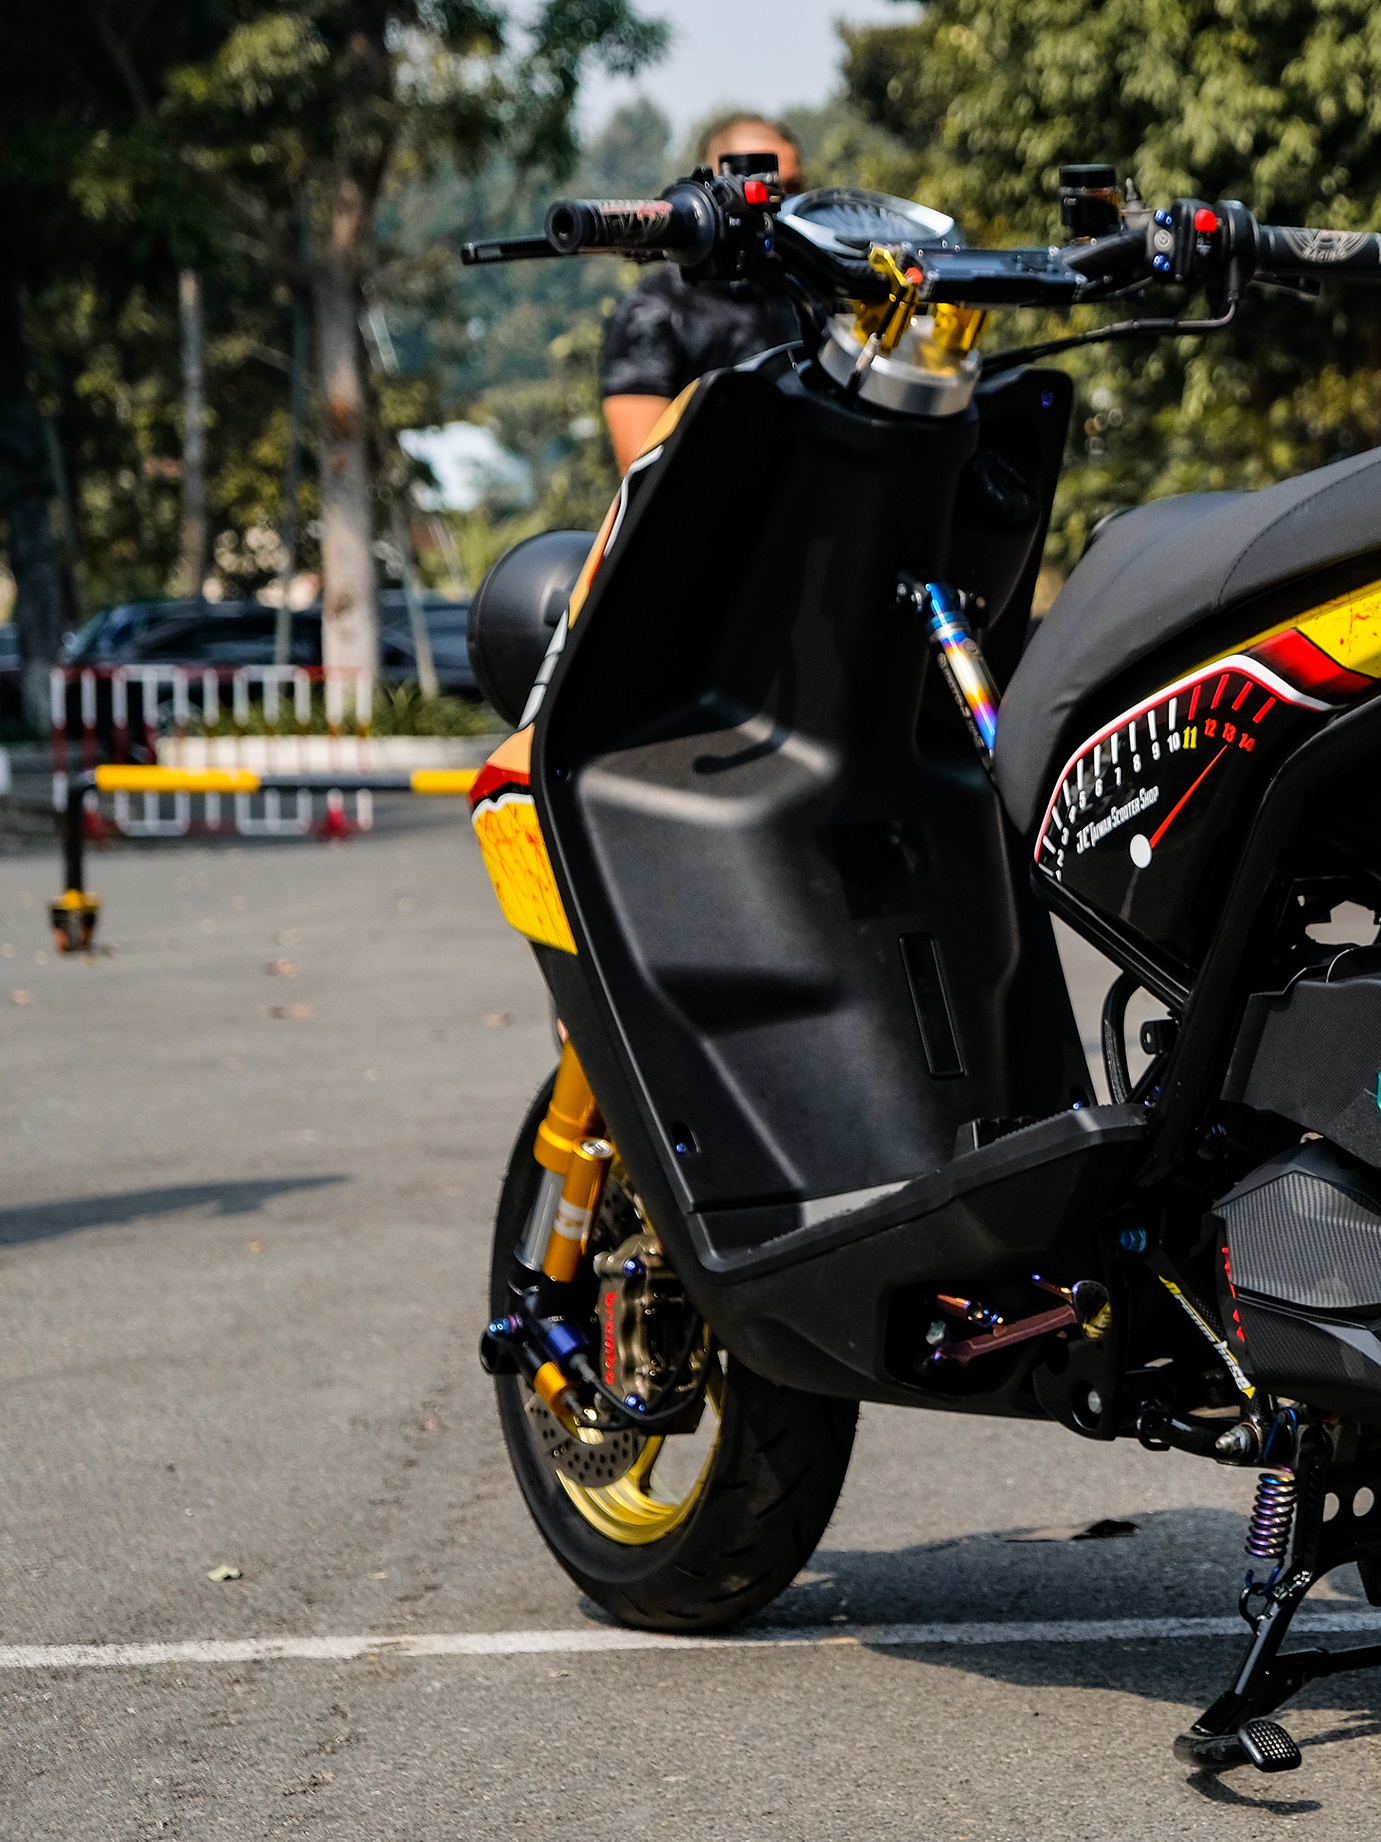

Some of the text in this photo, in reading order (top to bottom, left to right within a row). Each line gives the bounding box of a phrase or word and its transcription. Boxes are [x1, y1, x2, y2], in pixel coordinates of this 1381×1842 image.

[1056, 848, 1065, 868] 2
[1061, 826, 1070, 846] 3
[1068, 805, 1077, 824] 4
[1079, 790, 1087, 810] 5
[1095, 778, 1104, 798] 6
[1132, 753, 1142, 773] 8
[1151, 741, 1161, 761] 9
[1167, 731, 1181, 754] 10
[1182, 725, 1198, 749] 11
[1204, 718, 1218, 738] 12
[1222, 722, 1237, 743] 13
[1238, 732, 1256, 752] 14
[604, 1291, 617, 1385] brembo
